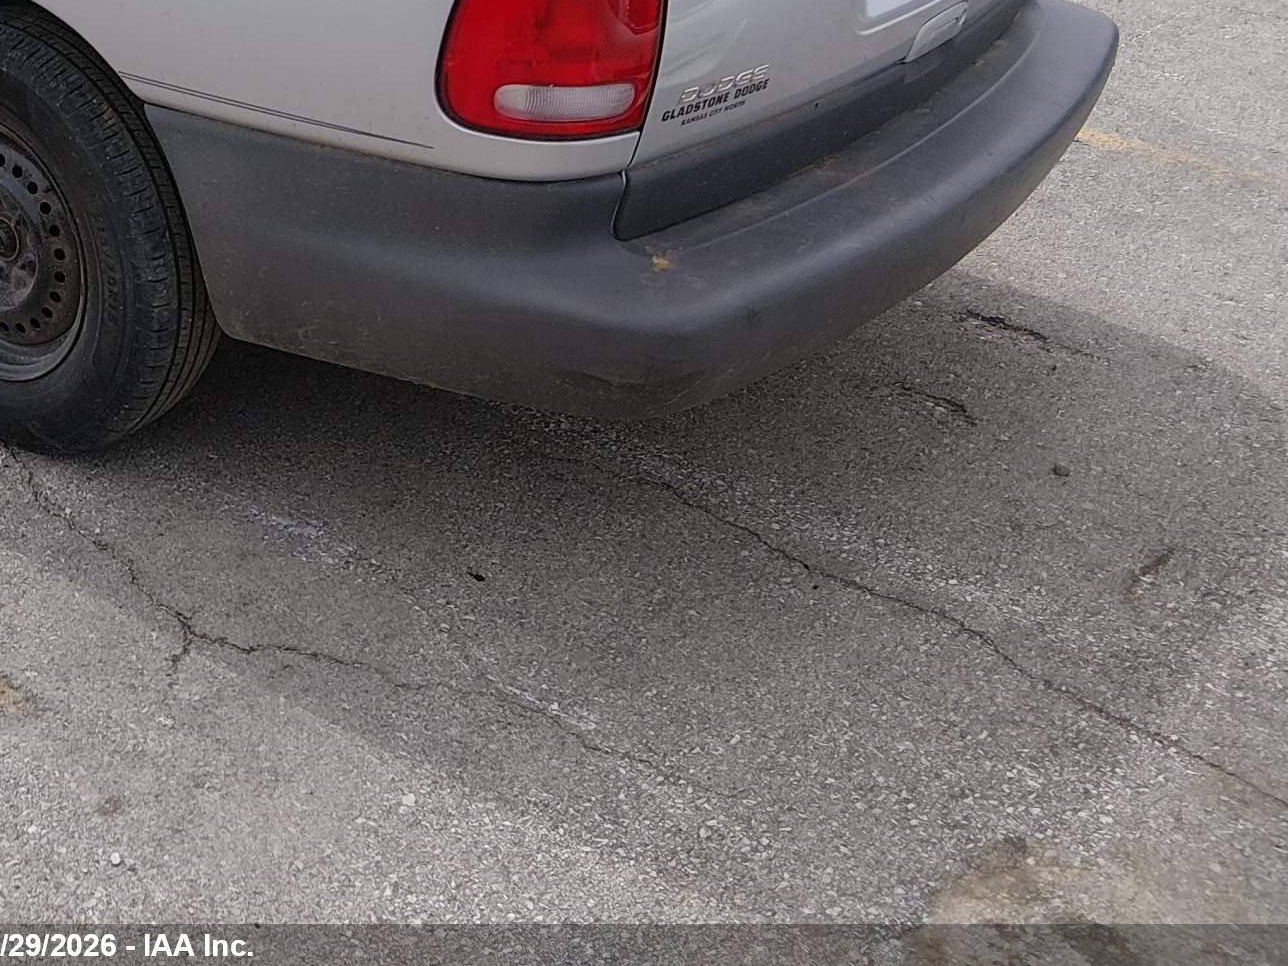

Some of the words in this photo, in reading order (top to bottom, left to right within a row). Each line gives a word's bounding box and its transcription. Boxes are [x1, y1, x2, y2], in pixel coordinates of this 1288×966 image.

[661, 91, 730, 122] GLADSTONE
[734, 78, 769, 99] DODGE
[680, 63, 770, 103] DODGE
[681, 113, 708, 125] KANSAS
[709, 107, 723, 118] CITY
